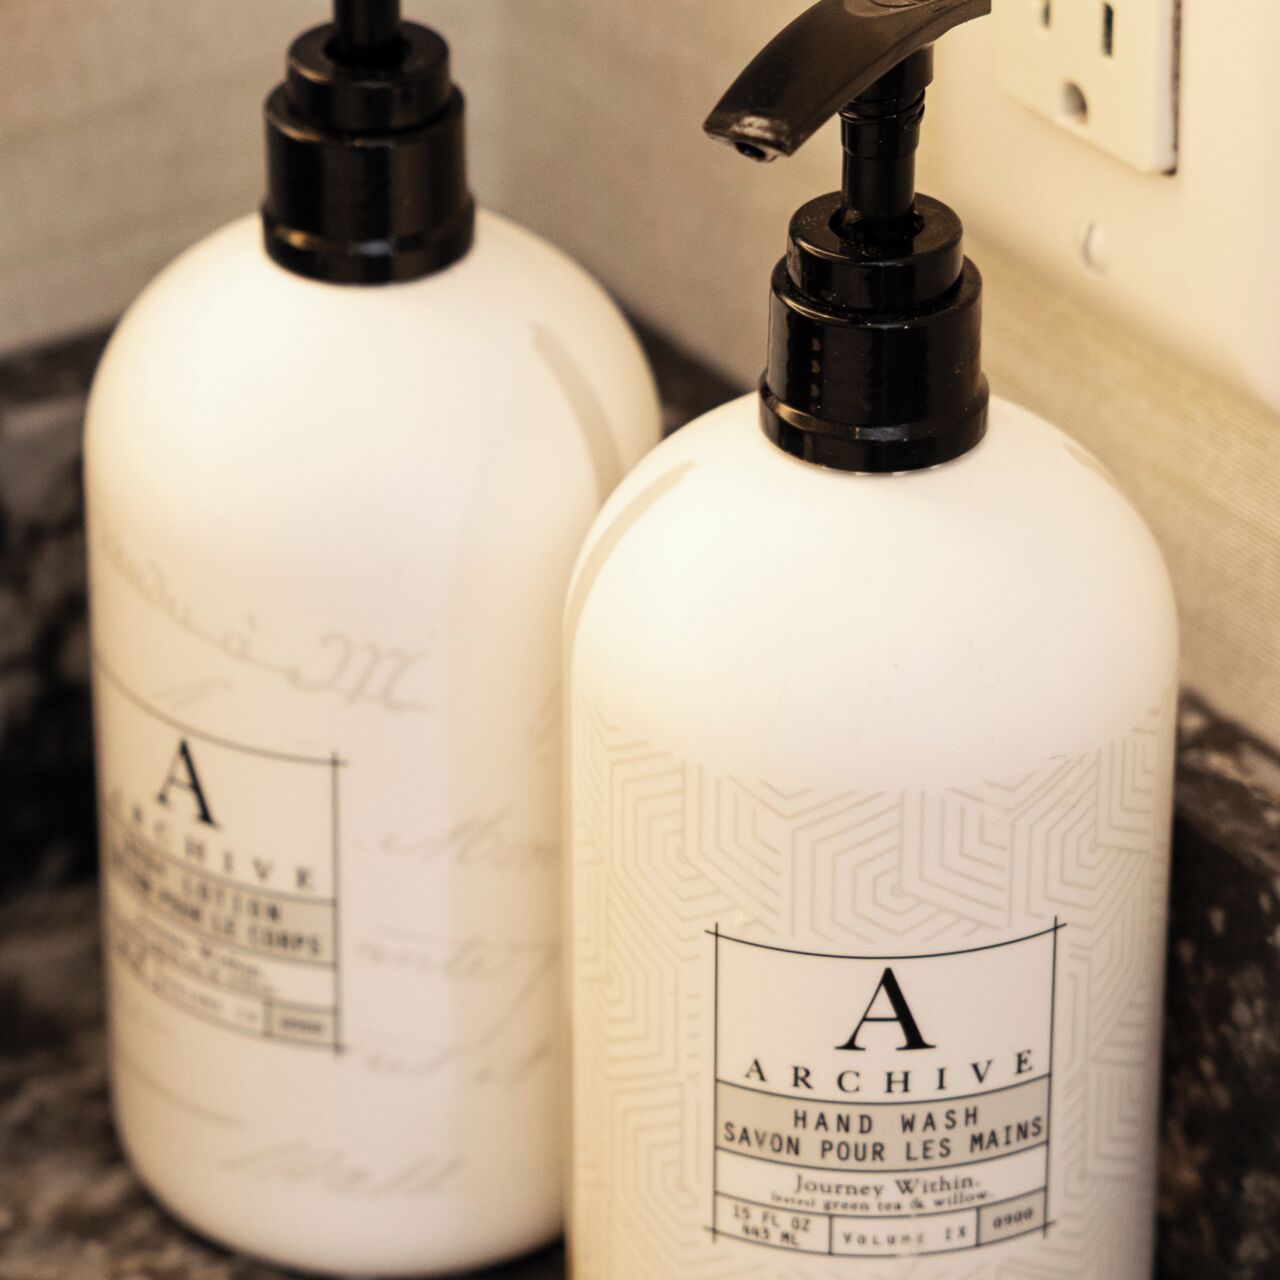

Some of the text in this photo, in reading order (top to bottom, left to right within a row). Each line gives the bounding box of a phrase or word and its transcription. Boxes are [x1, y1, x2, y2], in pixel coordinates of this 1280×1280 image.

[156, 738, 220, 831] A
[834, 967, 937, 1052] A
[745, 1050, 1033, 1094] ARCHIVE
[794, 1106, 979, 1135] HAND WASH
[723, 1116, 1043, 1162] SAVON POUR LES MAINS
[794, 1174, 885, 1198] Journey
[823, 1200, 871, 1213] green
[877, 1199, 901, 1211] tea
[761, 1212, 781, 1227] FL
[791, 1217, 811, 1231] OZ
[780, 1231, 800, 1246] ML
